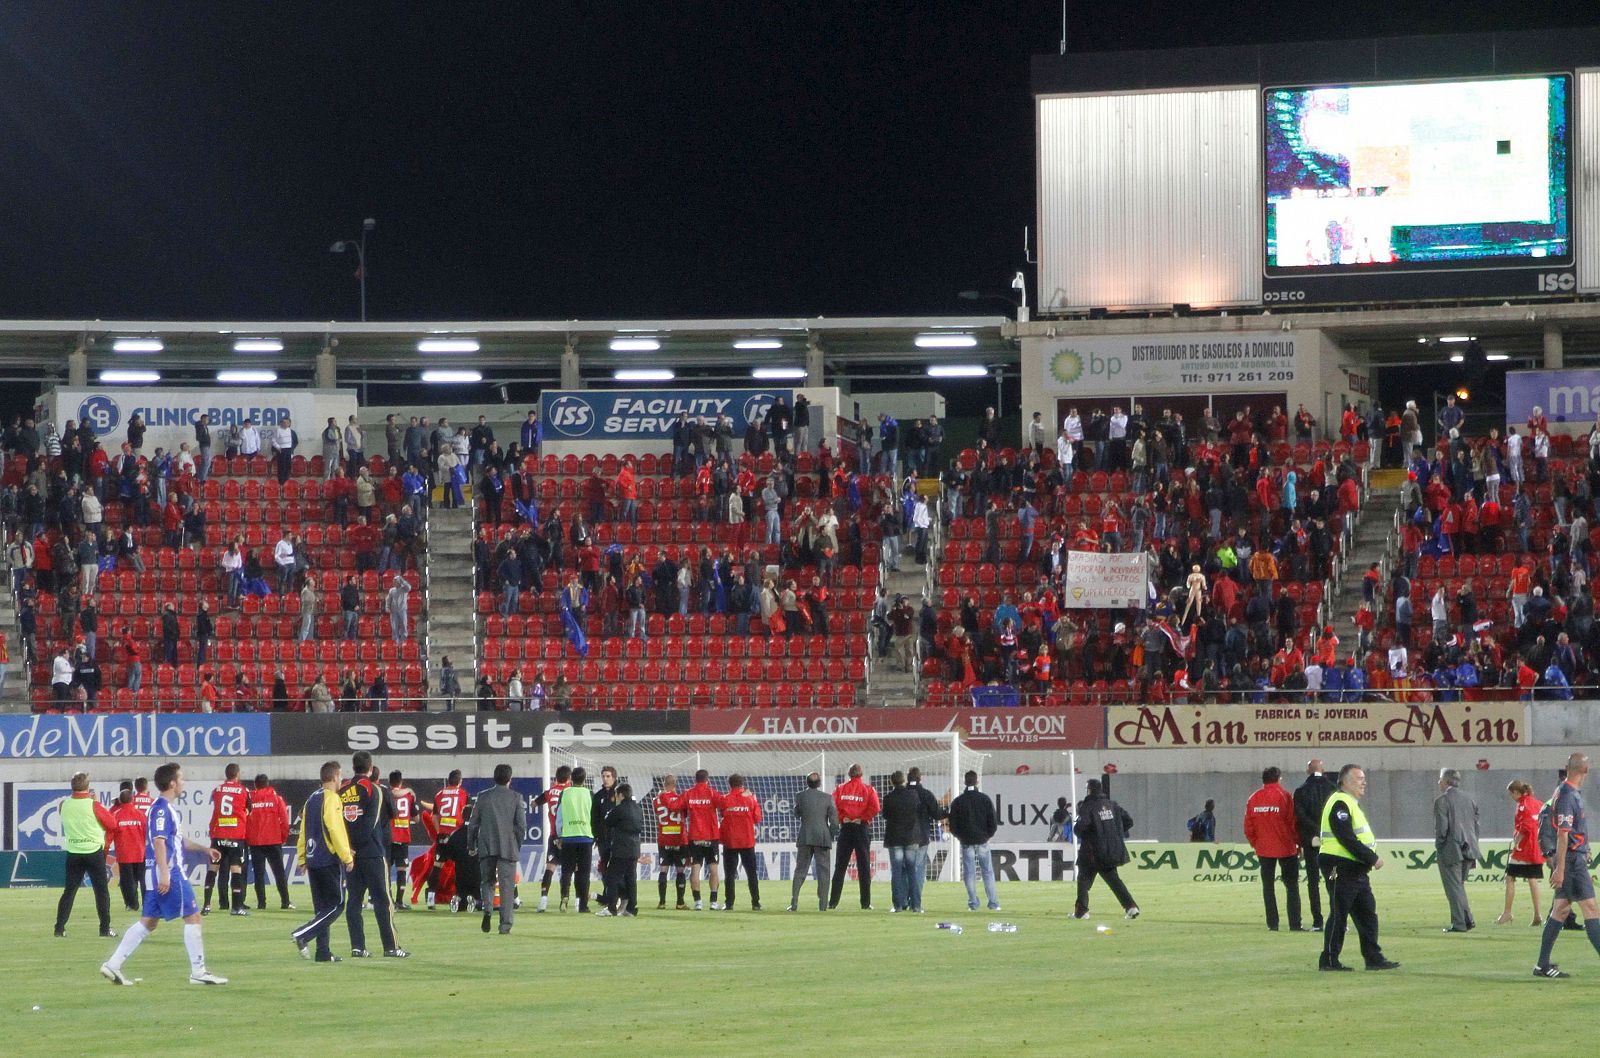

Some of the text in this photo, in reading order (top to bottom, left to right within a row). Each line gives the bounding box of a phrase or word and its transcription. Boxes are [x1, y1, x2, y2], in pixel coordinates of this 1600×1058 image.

[1538, 273, 1575, 291] ISO
[1132, 341, 1294, 361] DISTRIBUIDOR DE GASOLEOS A DOMICILIO
[1090, 352, 1122, 380] bp
[1207, 372, 1232, 382] 971
[1238, 371, 1262, 382] 261
[1268, 371, 1294, 381] 209
[612, 398, 732, 416] FACILITY
[603, 416, 734, 434] SERVES
[1255, 708, 1301, 720] FABRICA
[1324, 708, 1368, 719] JOYERIA
[347, 714, 613, 752] sssit.es
[762, 716, 858, 735] HALCON
[969, 715, 1066, 736] HALCON
[998, 735, 1039, 744] VIAJES
[1254, 730, 1377, 742] TROFEOS Y GRABADOS
[220, 795, 234, 816] 6
[396, 798, 409, 817] 9
[439, 797, 459, 817] 21
[657, 807, 682, 826] 24
[1193, 873, 1259, 883] CAIXA DE
